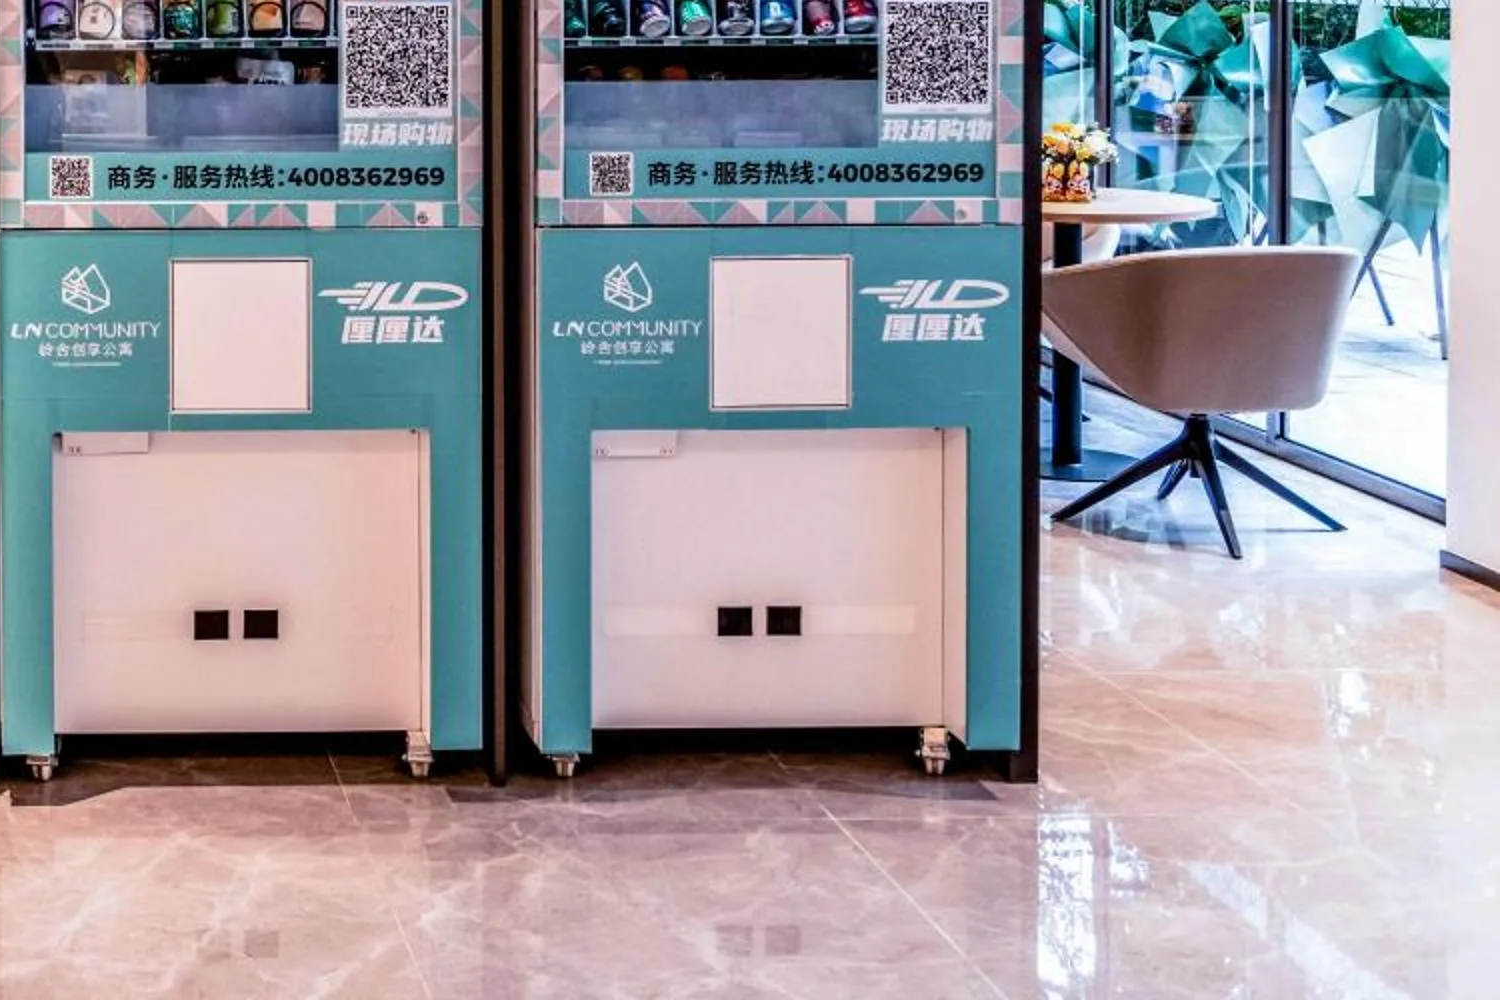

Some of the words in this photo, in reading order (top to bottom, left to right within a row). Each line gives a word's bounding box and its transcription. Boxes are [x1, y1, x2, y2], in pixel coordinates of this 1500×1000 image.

[343, 122, 453, 146] 现场购物
[880, 118, 993, 142] 现场购物
[341, 315, 445, 344] 厘厘达
[882, 313, 986, 342] 厘厘达
